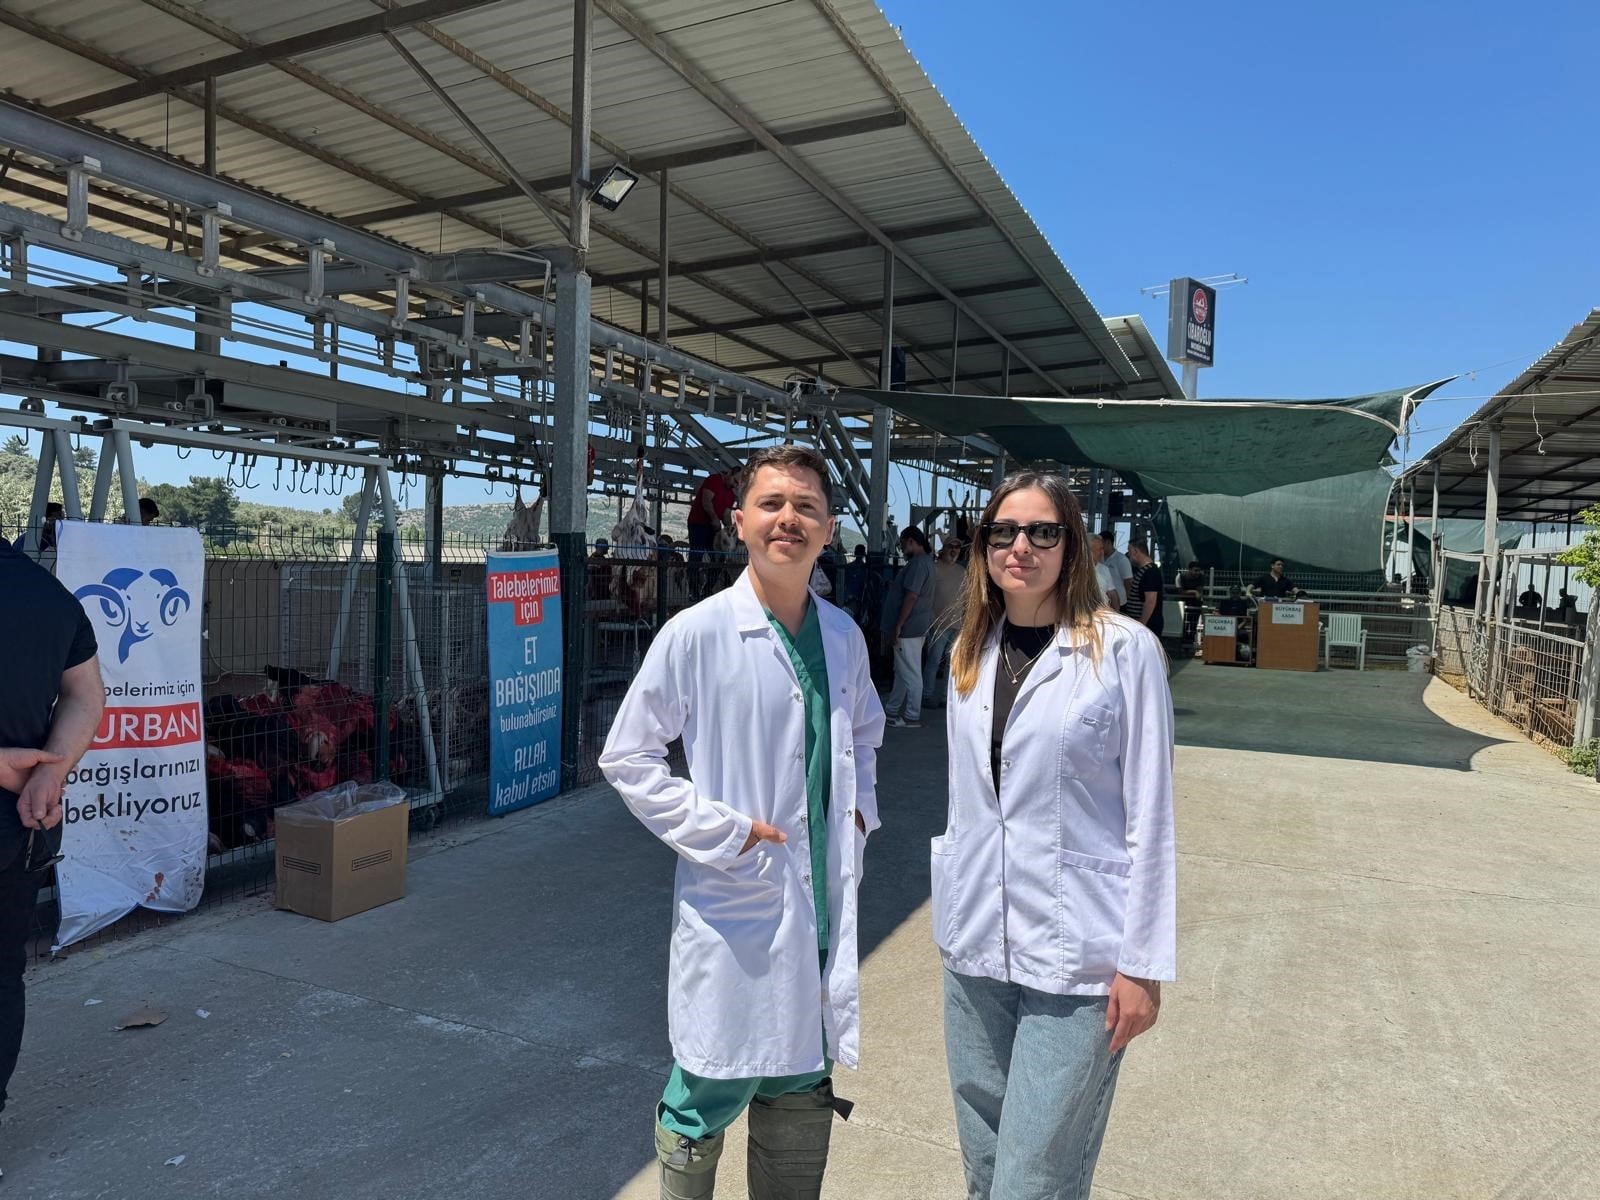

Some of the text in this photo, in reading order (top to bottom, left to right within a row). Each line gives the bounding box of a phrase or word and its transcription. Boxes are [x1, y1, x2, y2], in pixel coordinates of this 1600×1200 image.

[491, 571, 559, 599] Talebelerimiz
[520, 596, 539, 623] için
[524, 636, 538, 665] ET
[177, 679, 195, 697] için
[495, 667, 560, 708] BAĞIŞINDA
[93, 709, 198, 743] URBAN
[500, 703, 557, 733] bulunabilirsiniz
[515, 740, 546, 772] ALLAH
[494, 766, 556, 809] kabul etsin
[64, 791, 201, 825] bekliyoruz
